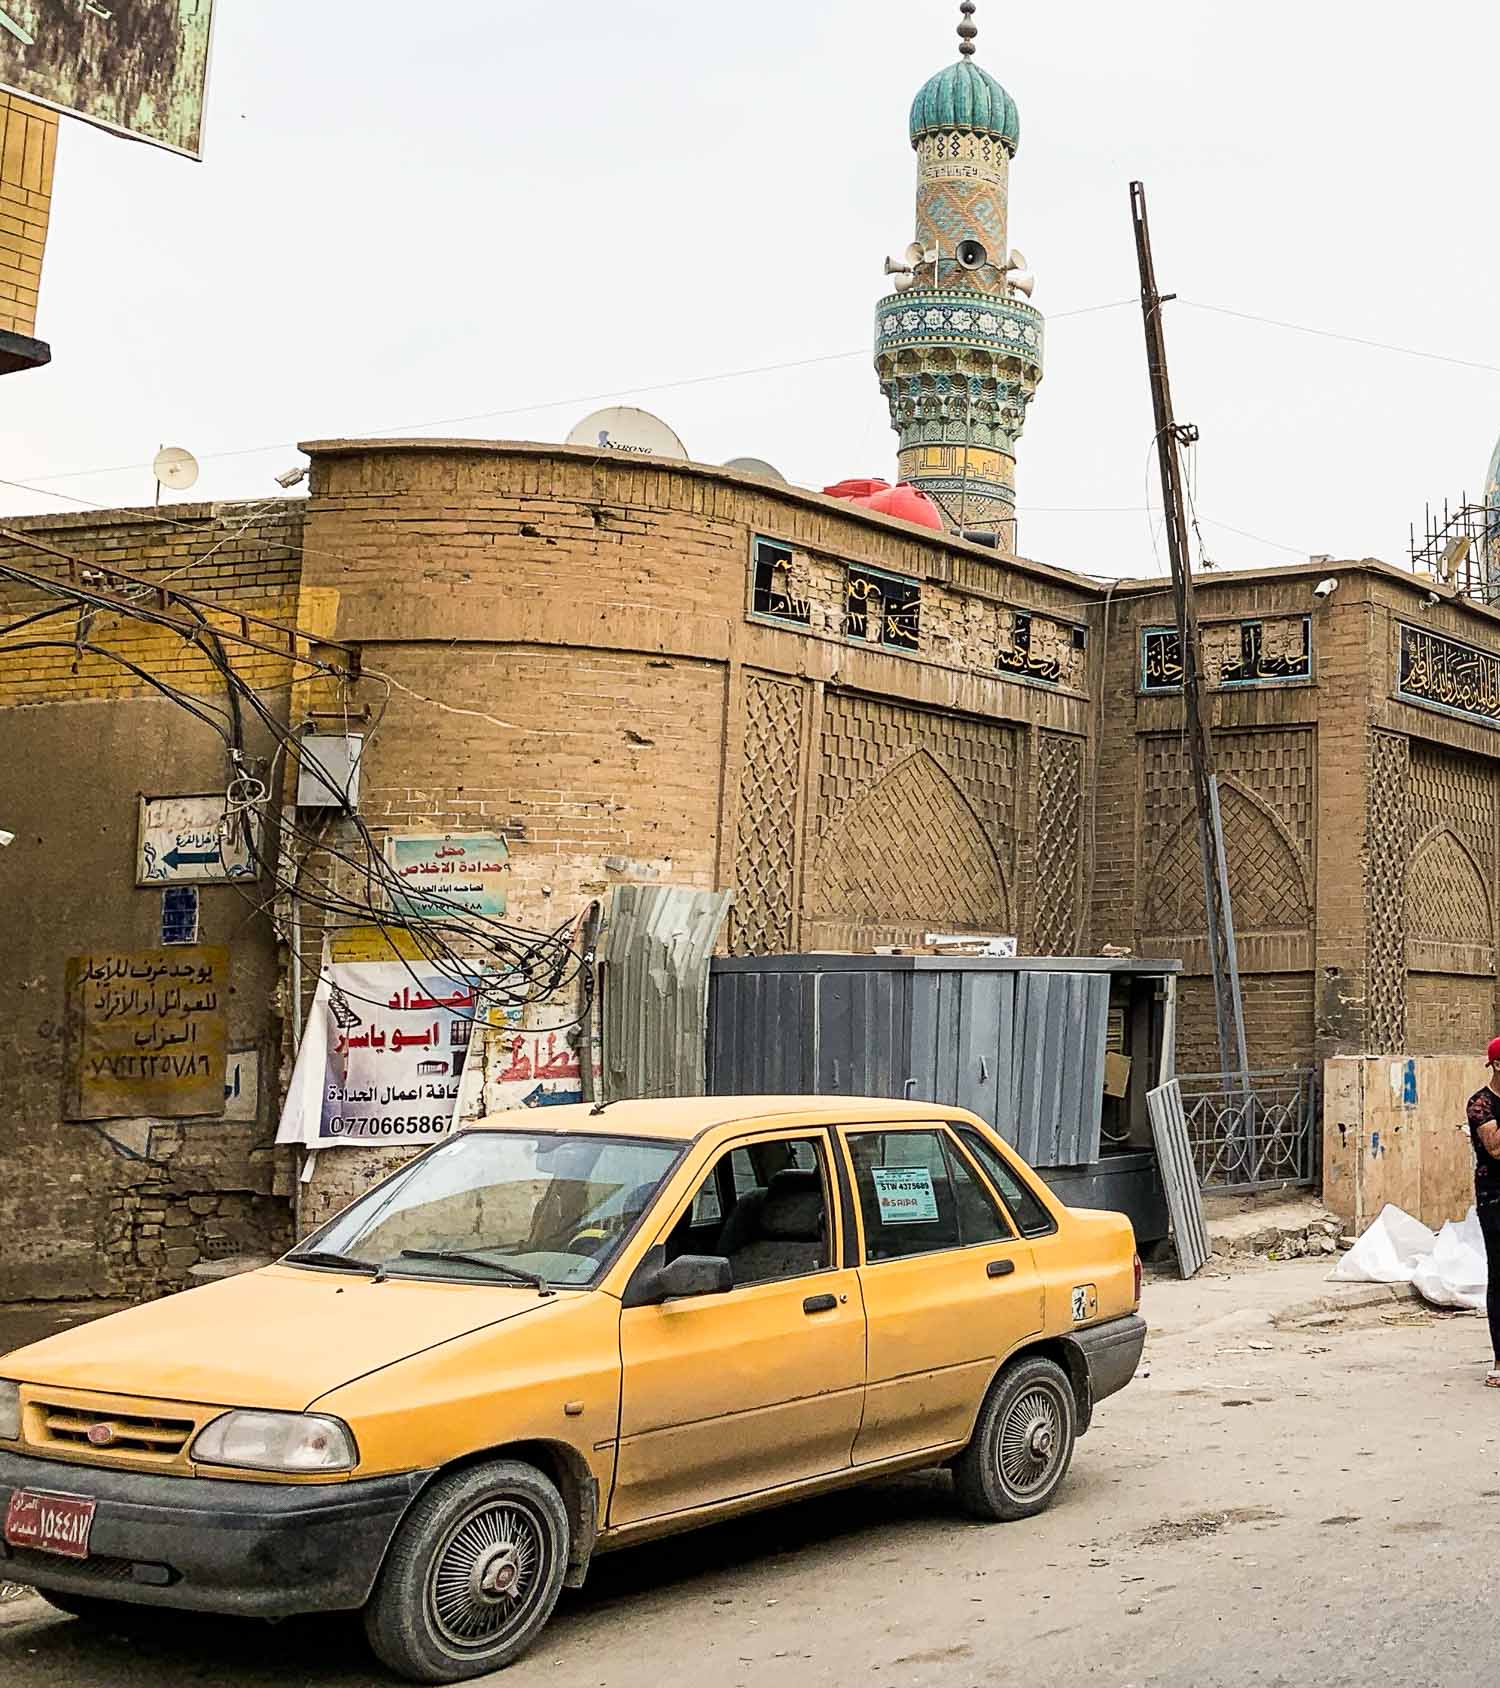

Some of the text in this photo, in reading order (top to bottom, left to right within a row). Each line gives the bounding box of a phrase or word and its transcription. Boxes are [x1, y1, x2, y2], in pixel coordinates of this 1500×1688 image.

[602, 440, 653, 454] STRONG
[434, 845, 466, 859] محل
[398, 860, 503, 878] حدادة الاخلاص
[130, 957, 168, 983] غرف
[170, 963, 214, 984] يوجد
[388, 985, 474, 1010] لحداد
[133, 1022, 197, 1050] العزاب
[390, 1021, 440, 1053] ابو
[328, 1084, 378, 1102] الحدادة
[380, 1084, 423, 1105] اعمال
